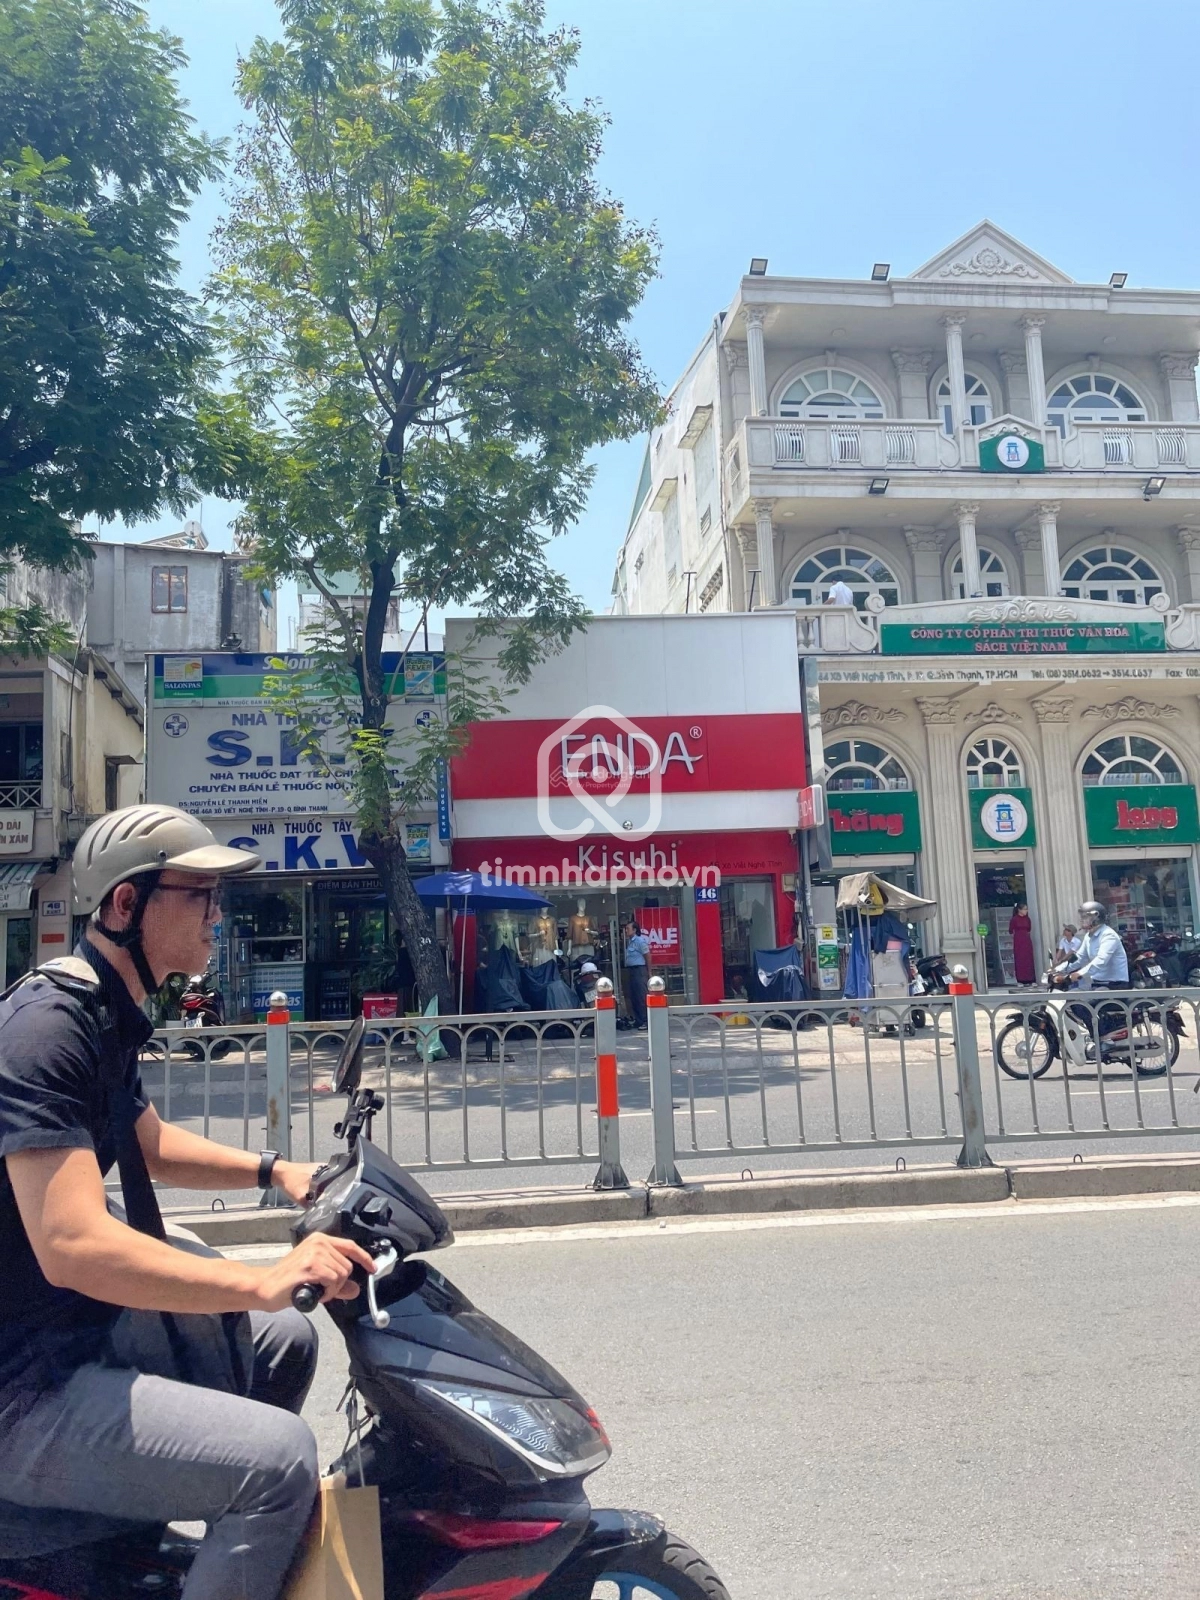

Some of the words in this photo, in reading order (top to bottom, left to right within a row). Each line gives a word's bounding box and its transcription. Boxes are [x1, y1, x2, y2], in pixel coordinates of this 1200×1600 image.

[911, 626, 943, 639] CÔNG
[946, 628, 962, 638] TY
[1019, 628, 1039, 637] TRI
[1077, 625, 1103, 637] VĂN
[975, 639, 1008, 652] SÁCH
[1010, 640, 1039, 653] VIỆT
[1041, 642, 1067, 651] NAM
[986, 669, 1018, 679] TP.HCM
[231, 710, 267, 727] NHÀ
[561, 732, 703, 778] ENDA
[210, 771, 234, 780] NHÀ
[238, 769, 277, 780] THUỐC
[279, 770, 302, 780] ĐẠT
[189, 783, 236, 793] CHUYÊN
[239, 782, 264, 793] BÁN
[283, 780, 322, 791] THUỐC
[1114, 800, 1178, 830] Long
[252, 821, 275, 836] NHÀ
[284, 819, 323, 835] THUỐC
[332, 819, 352, 833] TÂY
[578, 843, 678, 871] Kisuhi
[698, 887, 717, 899] 46
[640, 927, 678, 945] SALE
